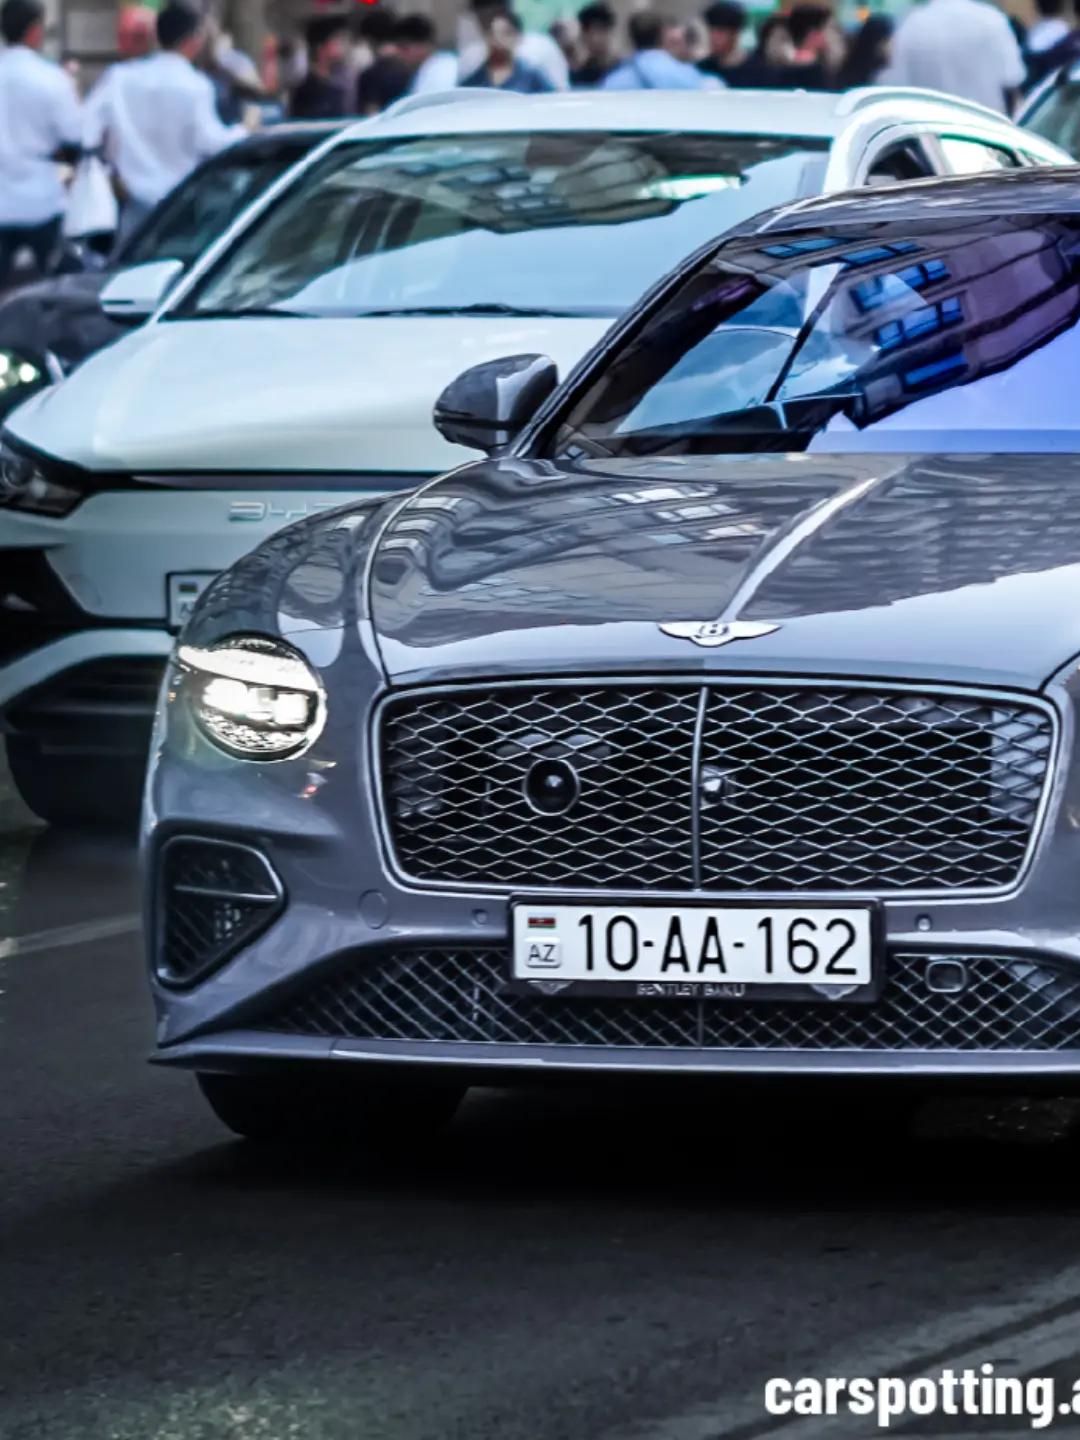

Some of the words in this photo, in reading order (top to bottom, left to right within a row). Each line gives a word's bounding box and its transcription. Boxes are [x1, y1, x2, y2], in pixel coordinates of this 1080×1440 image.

[527, 943, 556, 963] AZ
[577, 913, 858, 976] 10-AA-162
[637, 982, 699, 996] BENTLEY
[704, 983, 746, 997] BAKU
